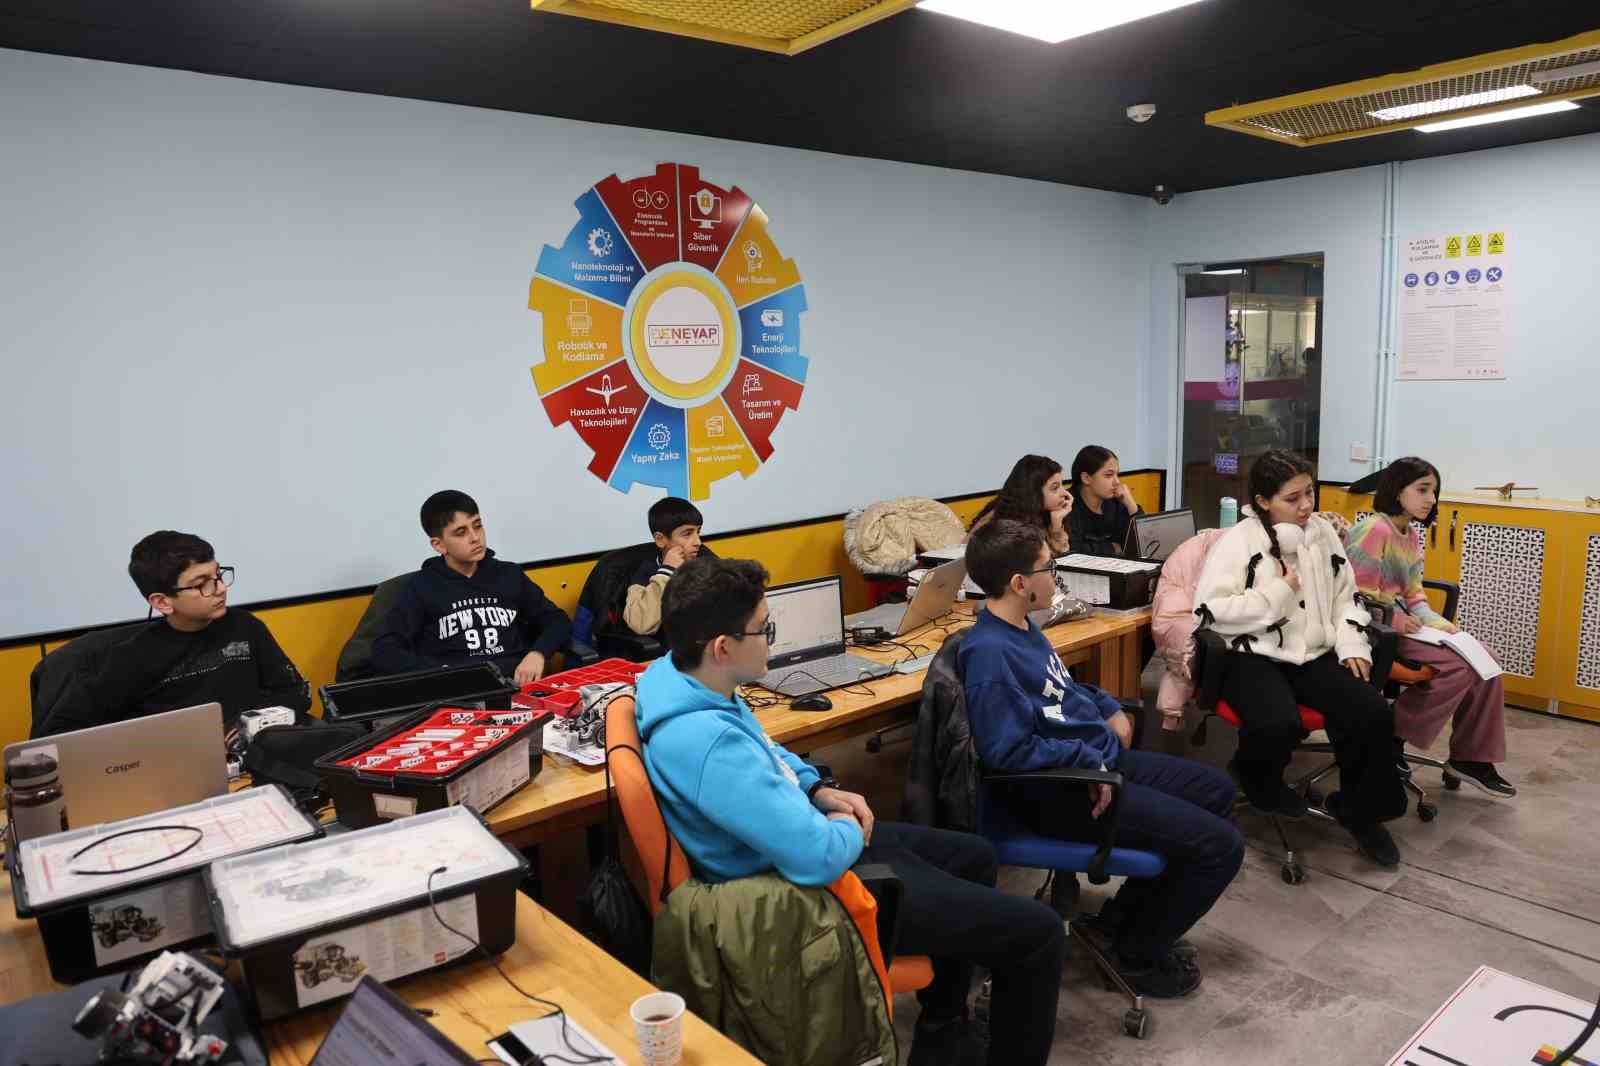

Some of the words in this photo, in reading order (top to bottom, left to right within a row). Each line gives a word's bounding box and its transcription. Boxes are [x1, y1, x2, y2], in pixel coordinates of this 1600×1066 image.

[693, 232, 712, 241] Siber
[688, 243, 719, 252] Güvenlik
[571, 261, 624, 272] Nanoteknoloji
[609, 273, 631, 283] Bilimi
[563, 351, 604, 361] Kodlama
[570, 407, 606, 416] Havacılık
[608, 407, 617, 415] ve
[619, 406, 637, 415] Uzay
[579, 418, 627, 428] Teknolojileri
[632, 454, 657, 464] Yapay
[439, 609, 473, 639] NEW
[105, 761, 141, 774] Casper
